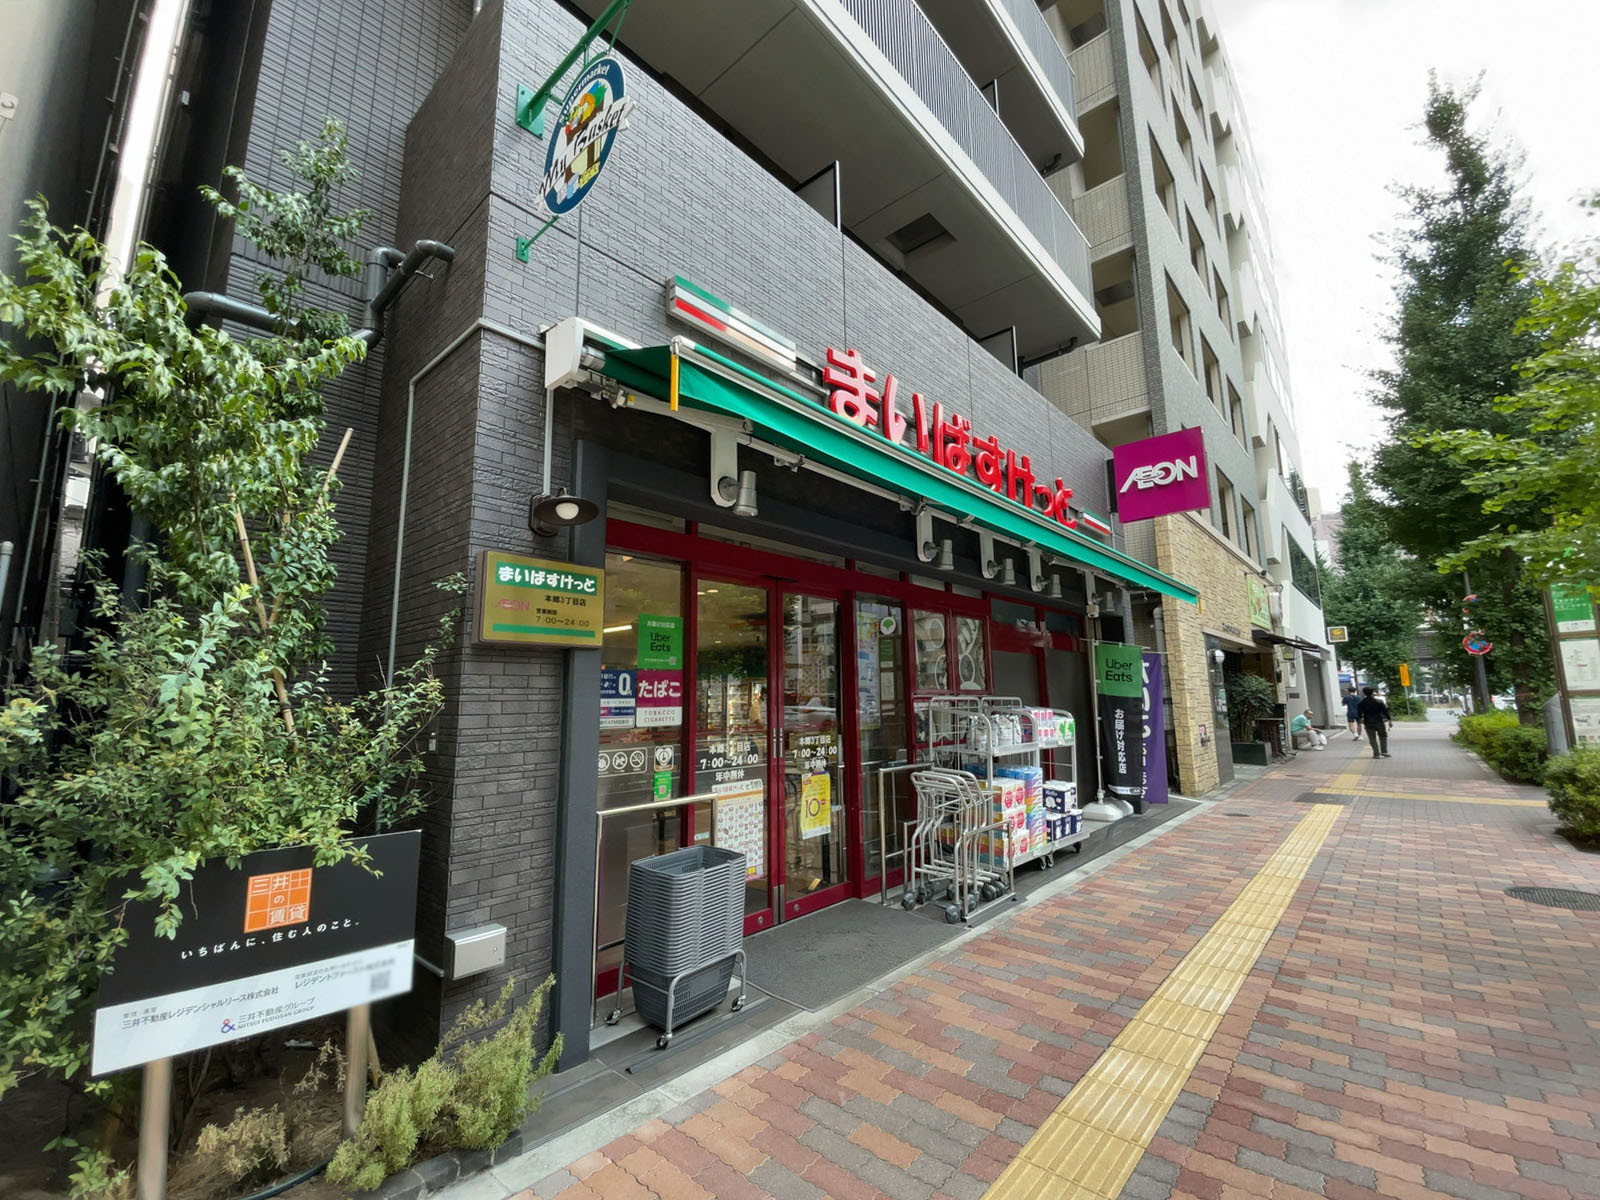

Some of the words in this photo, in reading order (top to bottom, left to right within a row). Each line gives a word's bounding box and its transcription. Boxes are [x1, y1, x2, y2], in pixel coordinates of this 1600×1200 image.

[573, 104, 625, 156] Basket
[823, 347, 1077, 530] まいばすけっと
[498, 566, 596, 592] まいばすけっと
[650, 632, 671, 641] Uber
[650, 642, 671, 652] Eats
[1105, 658, 1132, 670] Uber
[1105, 671, 1133, 683] Eats
[639, 680, 681, 698] たばこ
[1115, 708, 1127, 774] お届け対応店
[804, 759, 827, 770] 年中無休
[715, 769, 745, 781] 年中無休
[122, 986, 279, 1030] 三井不動産レジデンシャルリース株式会社
[238, 997, 315, 1023] 三井不動産グループ
[294, 1005, 315, 1017] GROUP
